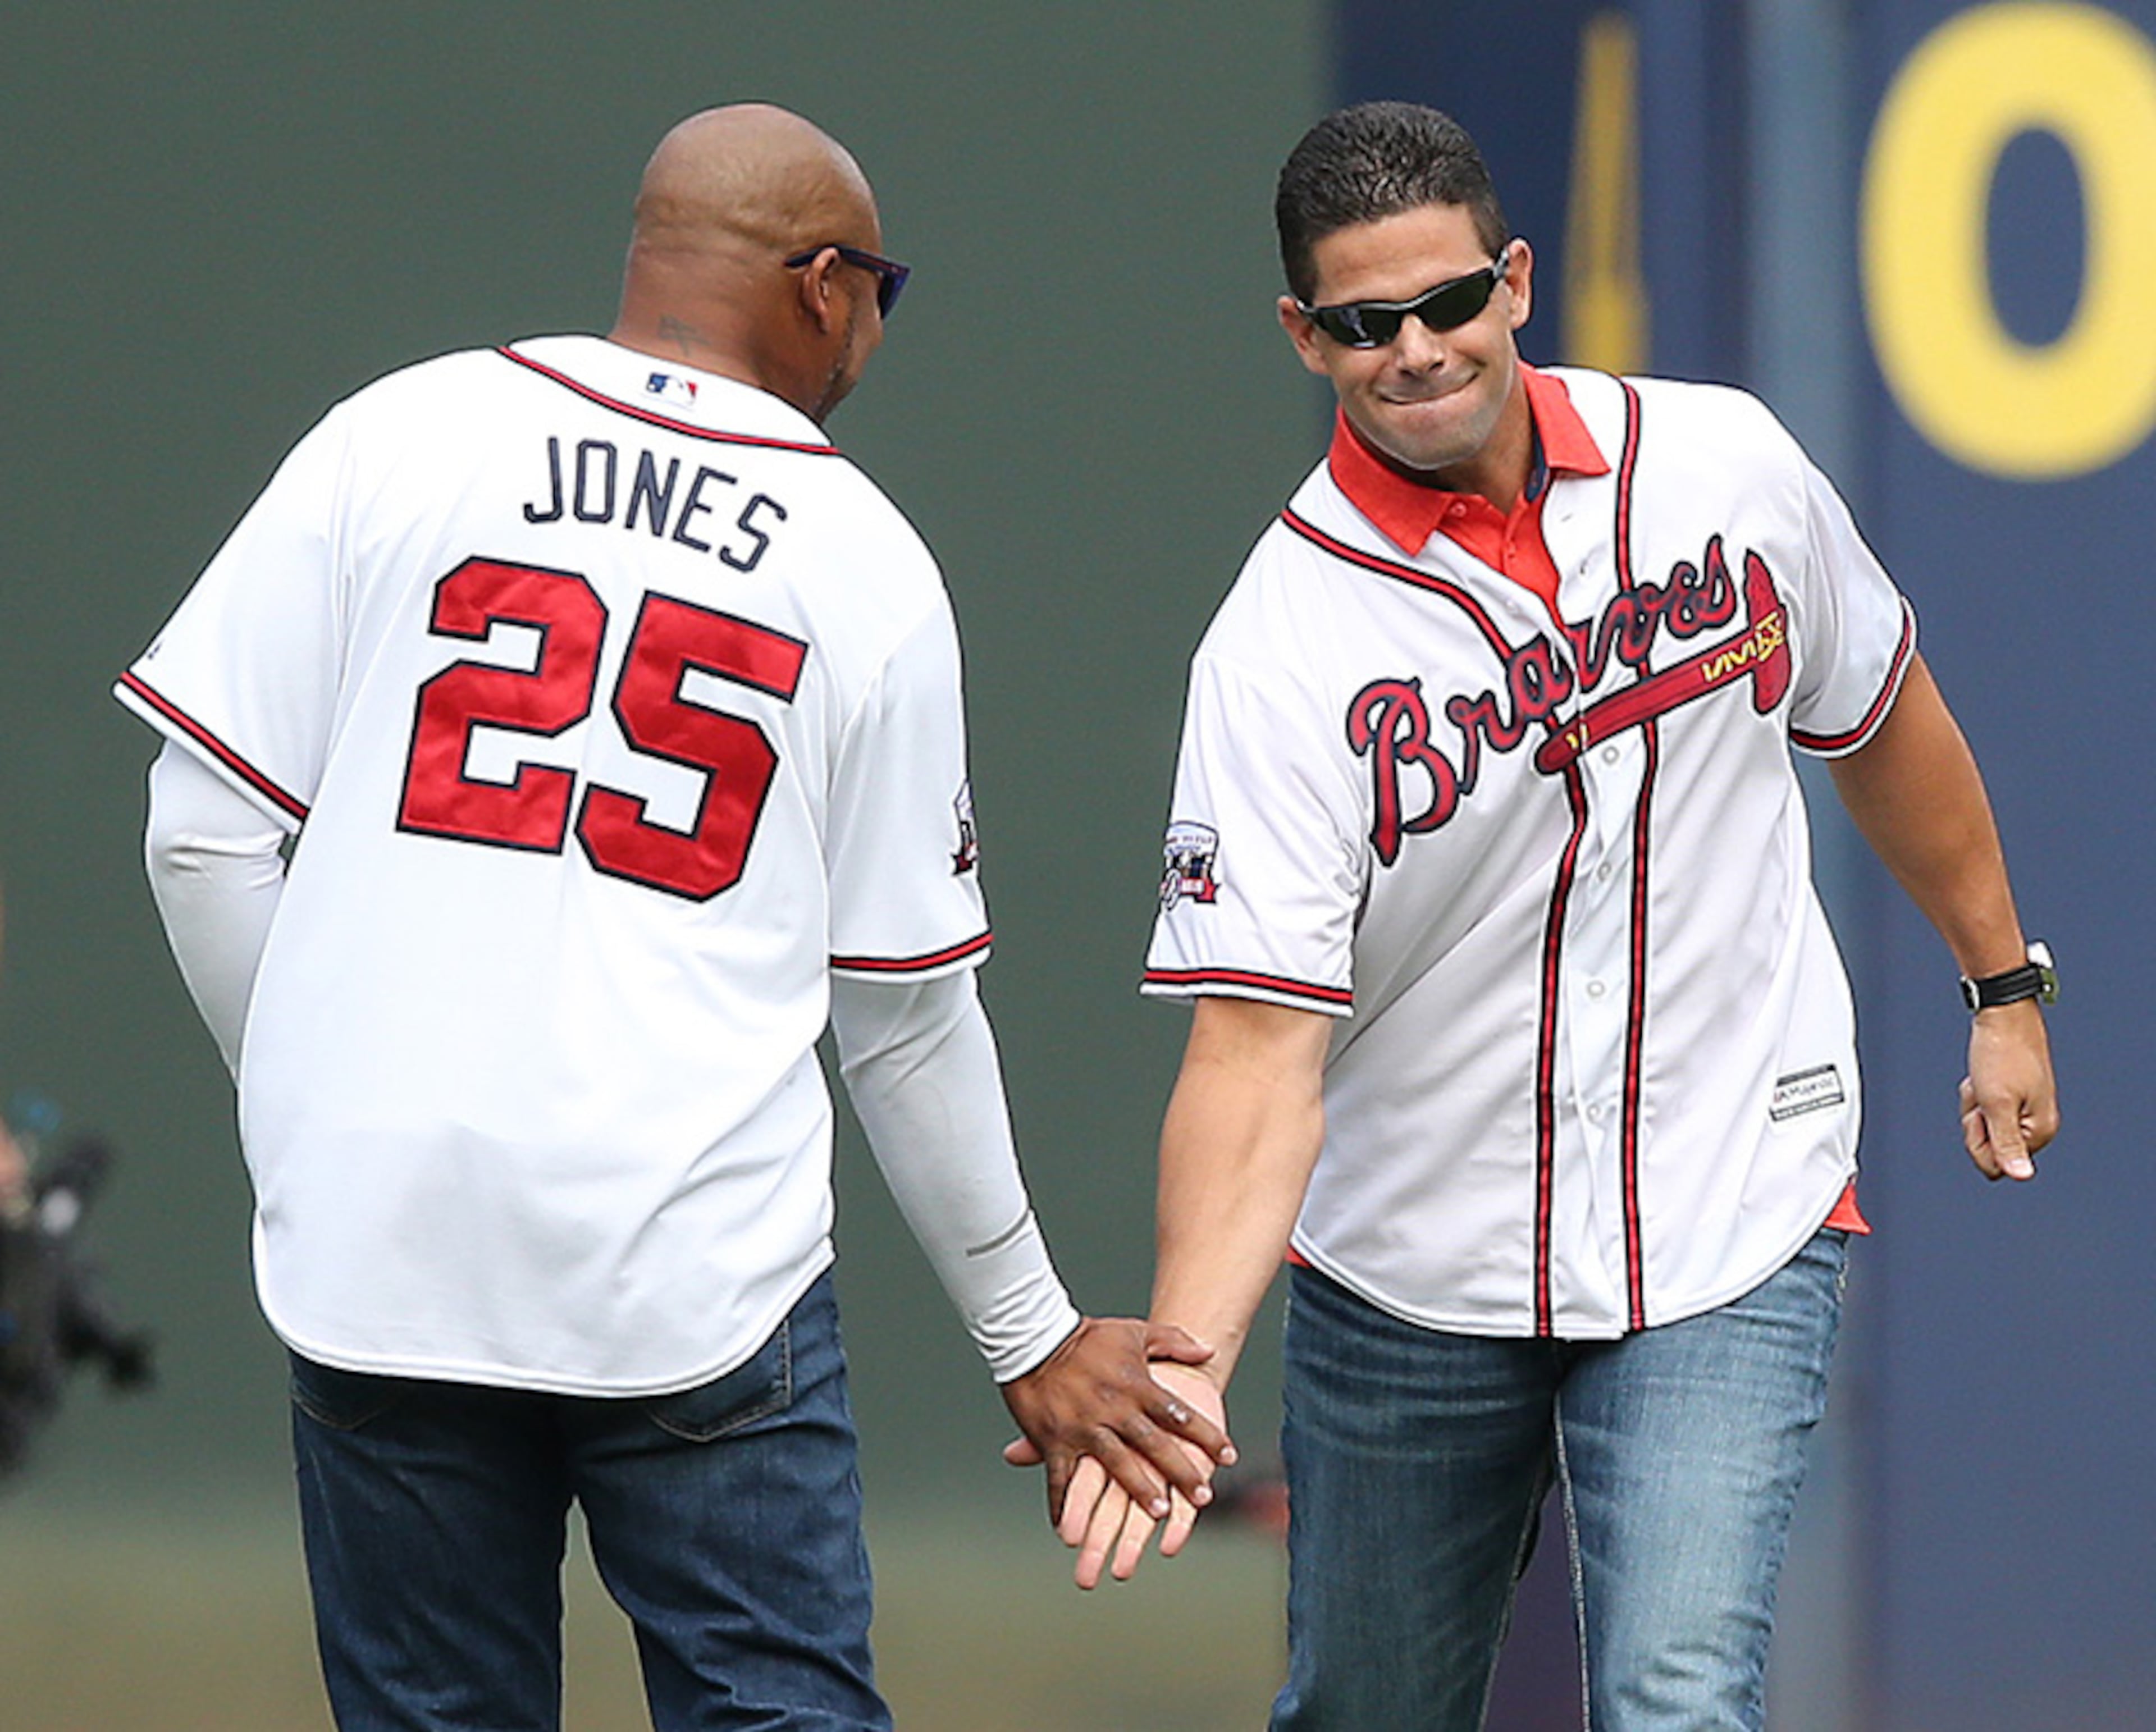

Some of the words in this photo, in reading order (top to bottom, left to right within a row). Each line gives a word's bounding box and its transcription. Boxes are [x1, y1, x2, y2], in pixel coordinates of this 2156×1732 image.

[523, 436, 787, 573] JONES
[395, 555, 809, 903] 25
[1346, 533, 1737, 868] Braves
